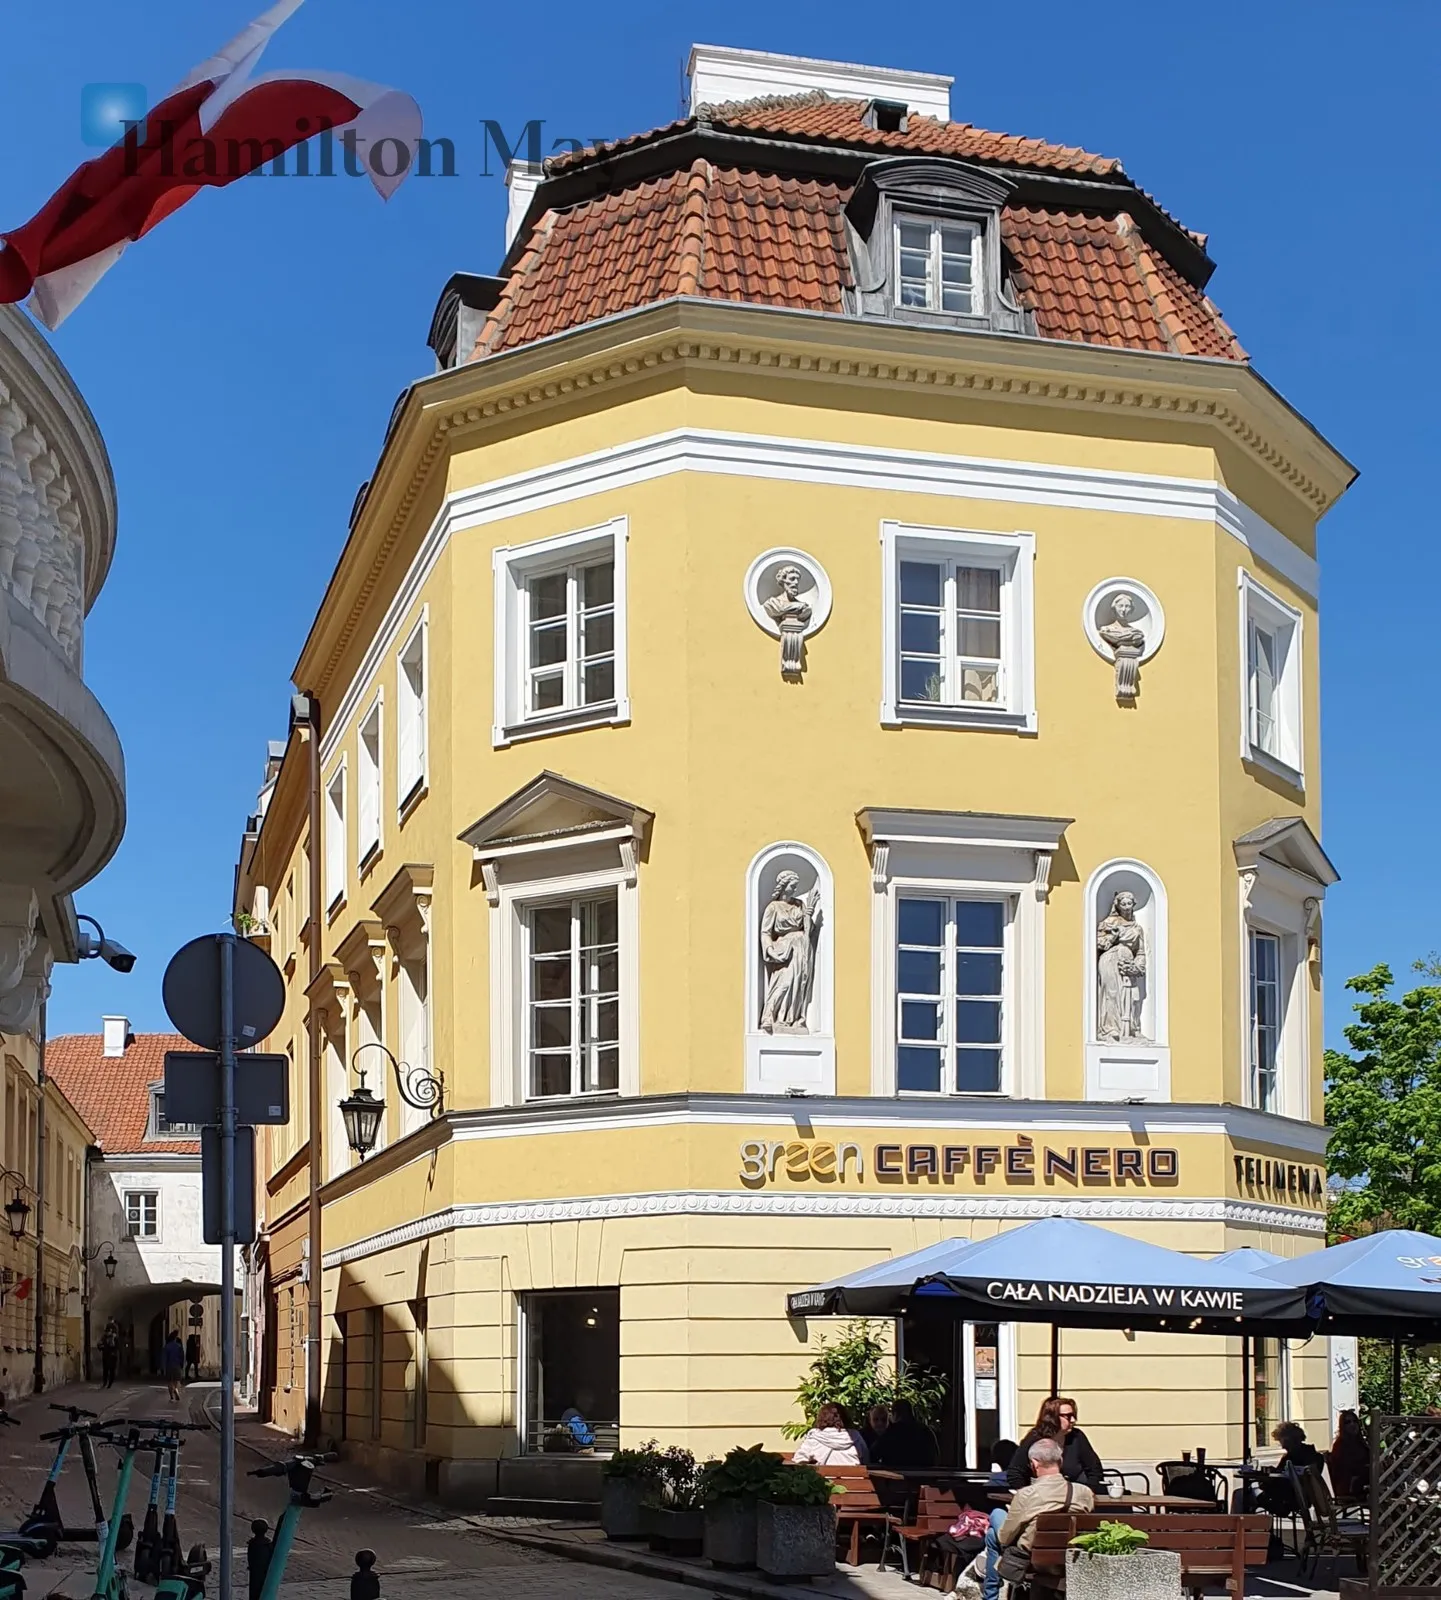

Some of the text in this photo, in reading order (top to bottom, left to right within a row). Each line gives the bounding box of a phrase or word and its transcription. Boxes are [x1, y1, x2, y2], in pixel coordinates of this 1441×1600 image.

[740, 1133, 1179, 1180] green CAFFÈ NERO
[1233, 1155, 1323, 1194] TELIMENA
[987, 1282, 1243, 1310] CAŁA NADZIEJA W KAWIE
